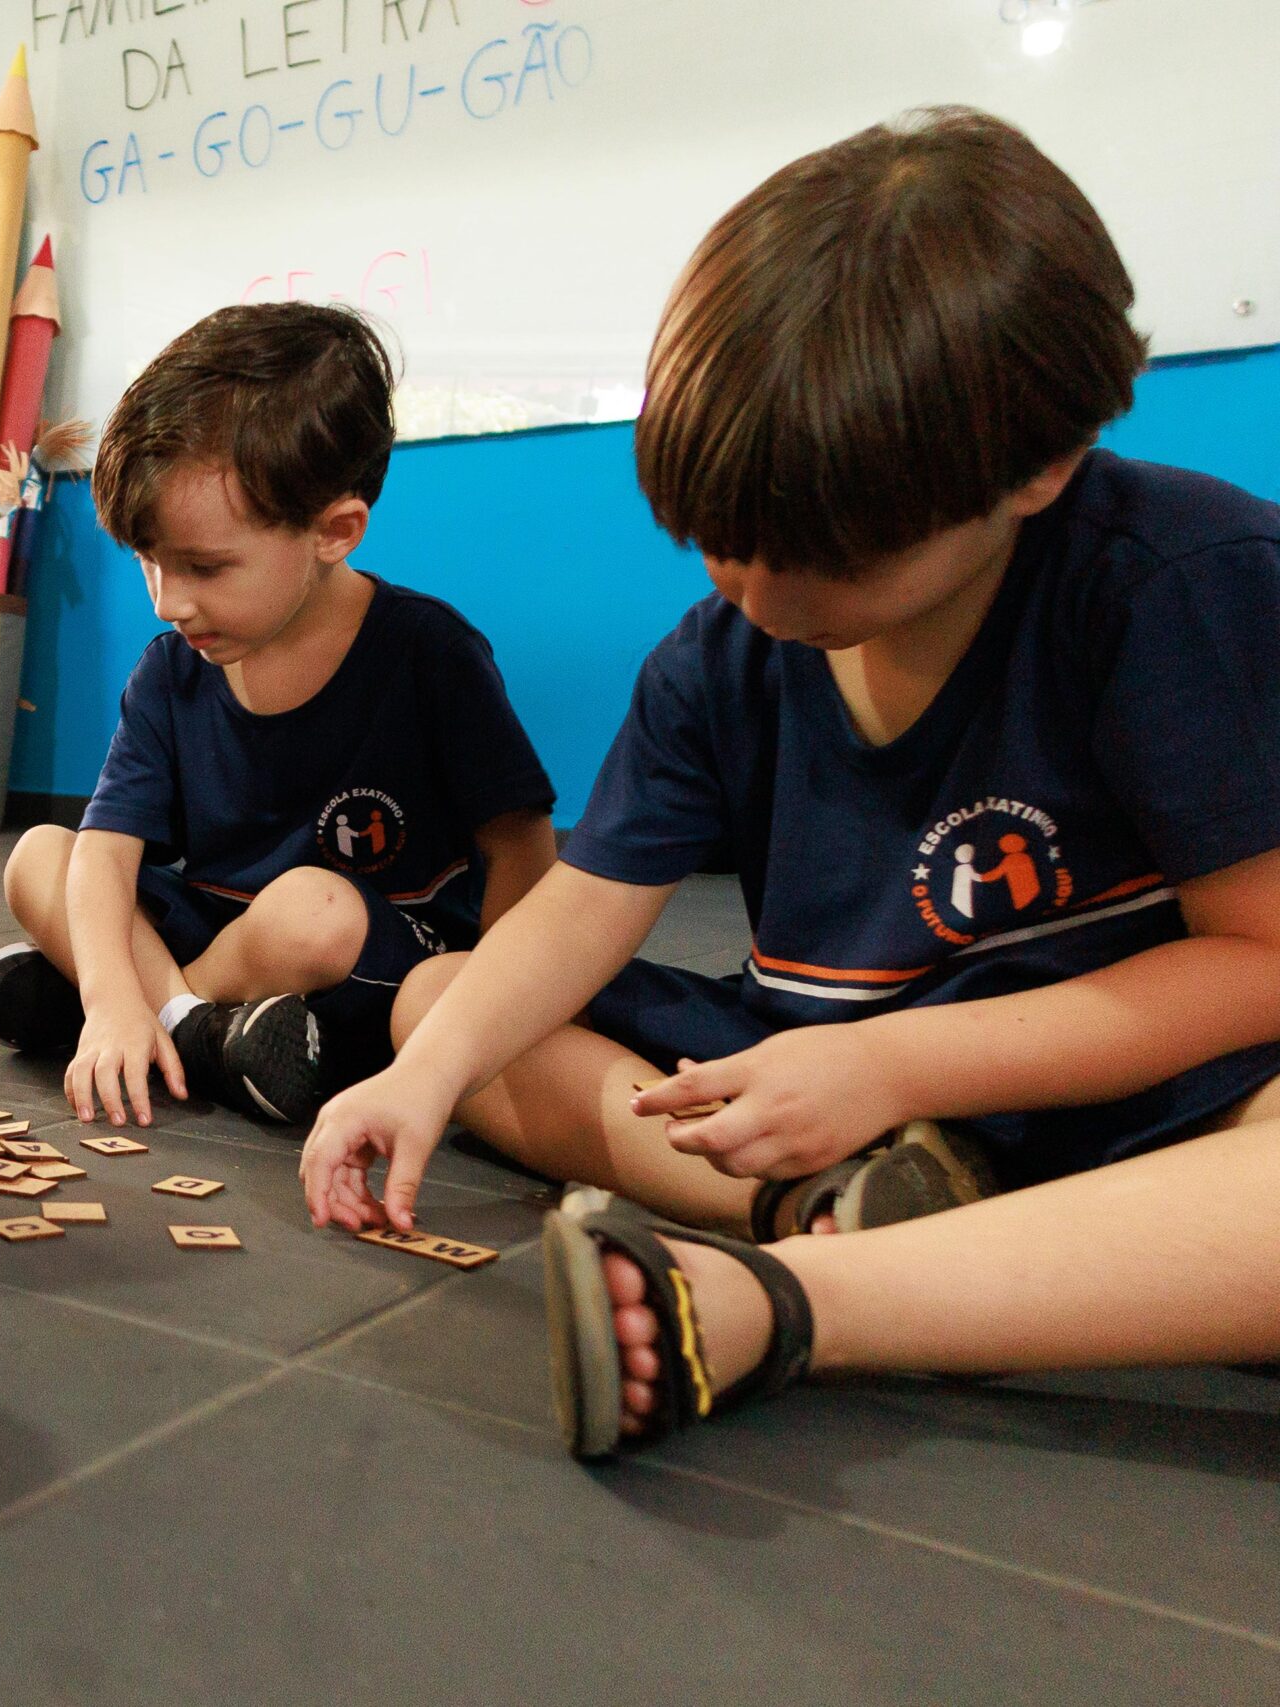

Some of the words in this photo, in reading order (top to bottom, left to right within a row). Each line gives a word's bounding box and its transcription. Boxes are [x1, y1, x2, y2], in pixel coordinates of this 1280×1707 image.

[122, 38, 192, 111] DA
[318, 791, 350, 827] ESCOLA
[351, 787, 404, 819] EXATINHO
[918, 801, 986, 856] ESCOLA
